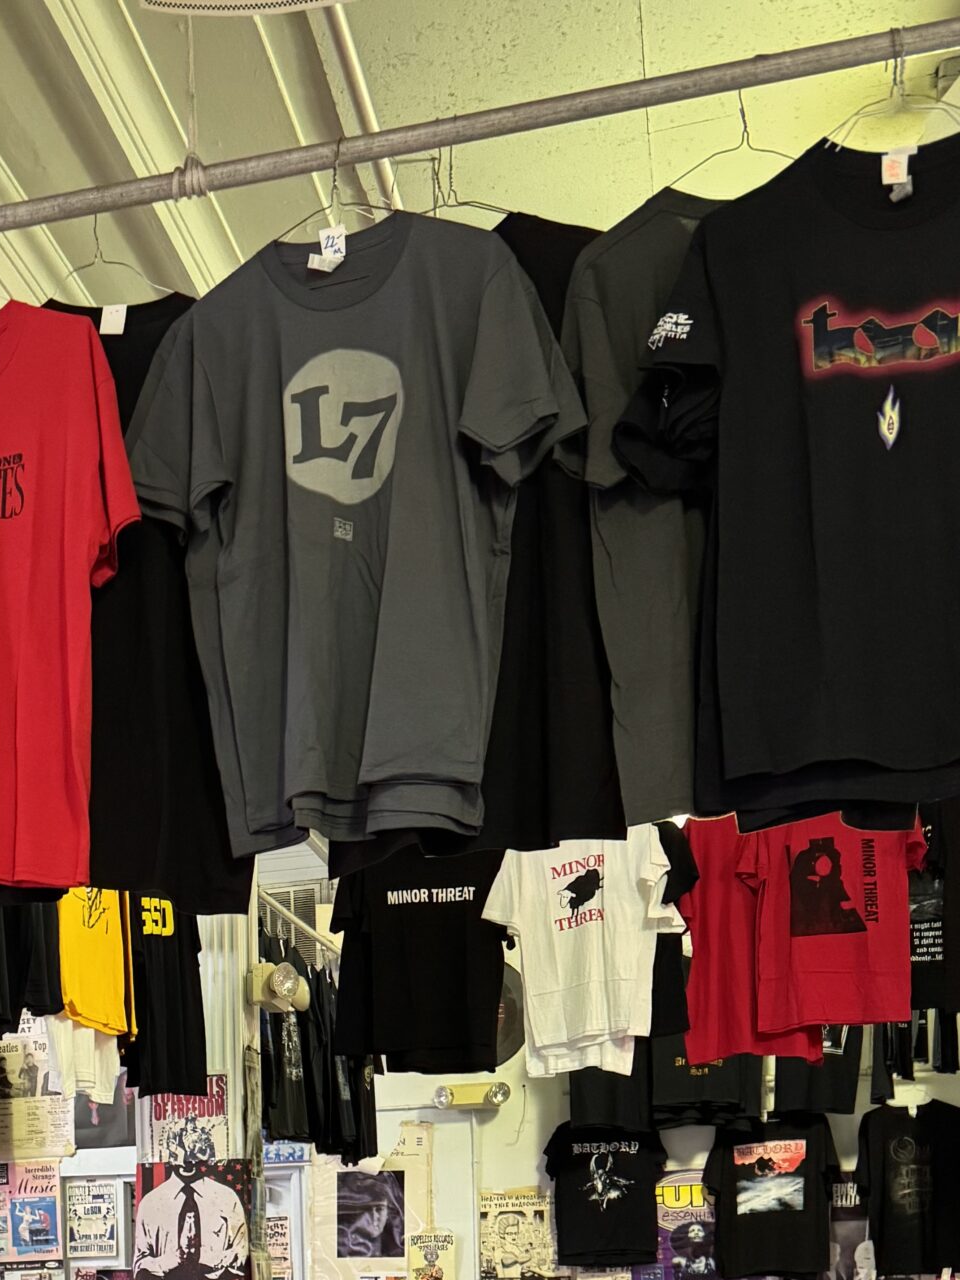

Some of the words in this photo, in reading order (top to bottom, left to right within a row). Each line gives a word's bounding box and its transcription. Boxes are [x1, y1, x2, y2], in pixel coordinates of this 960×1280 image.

[290, 384, 398, 481] L7
[550, 853, 604, 881] MINOR
[860, 838, 877, 878] MINOR
[387, 888, 430, 906] MINOR
[431, 885, 476, 904] THREAT
[865, 880, 880, 923] THREAT
[554, 907, 605, 933] THREA
[170, 1098, 226, 1120] FREEDOM
[14, 1178, 57, 1195] Music
